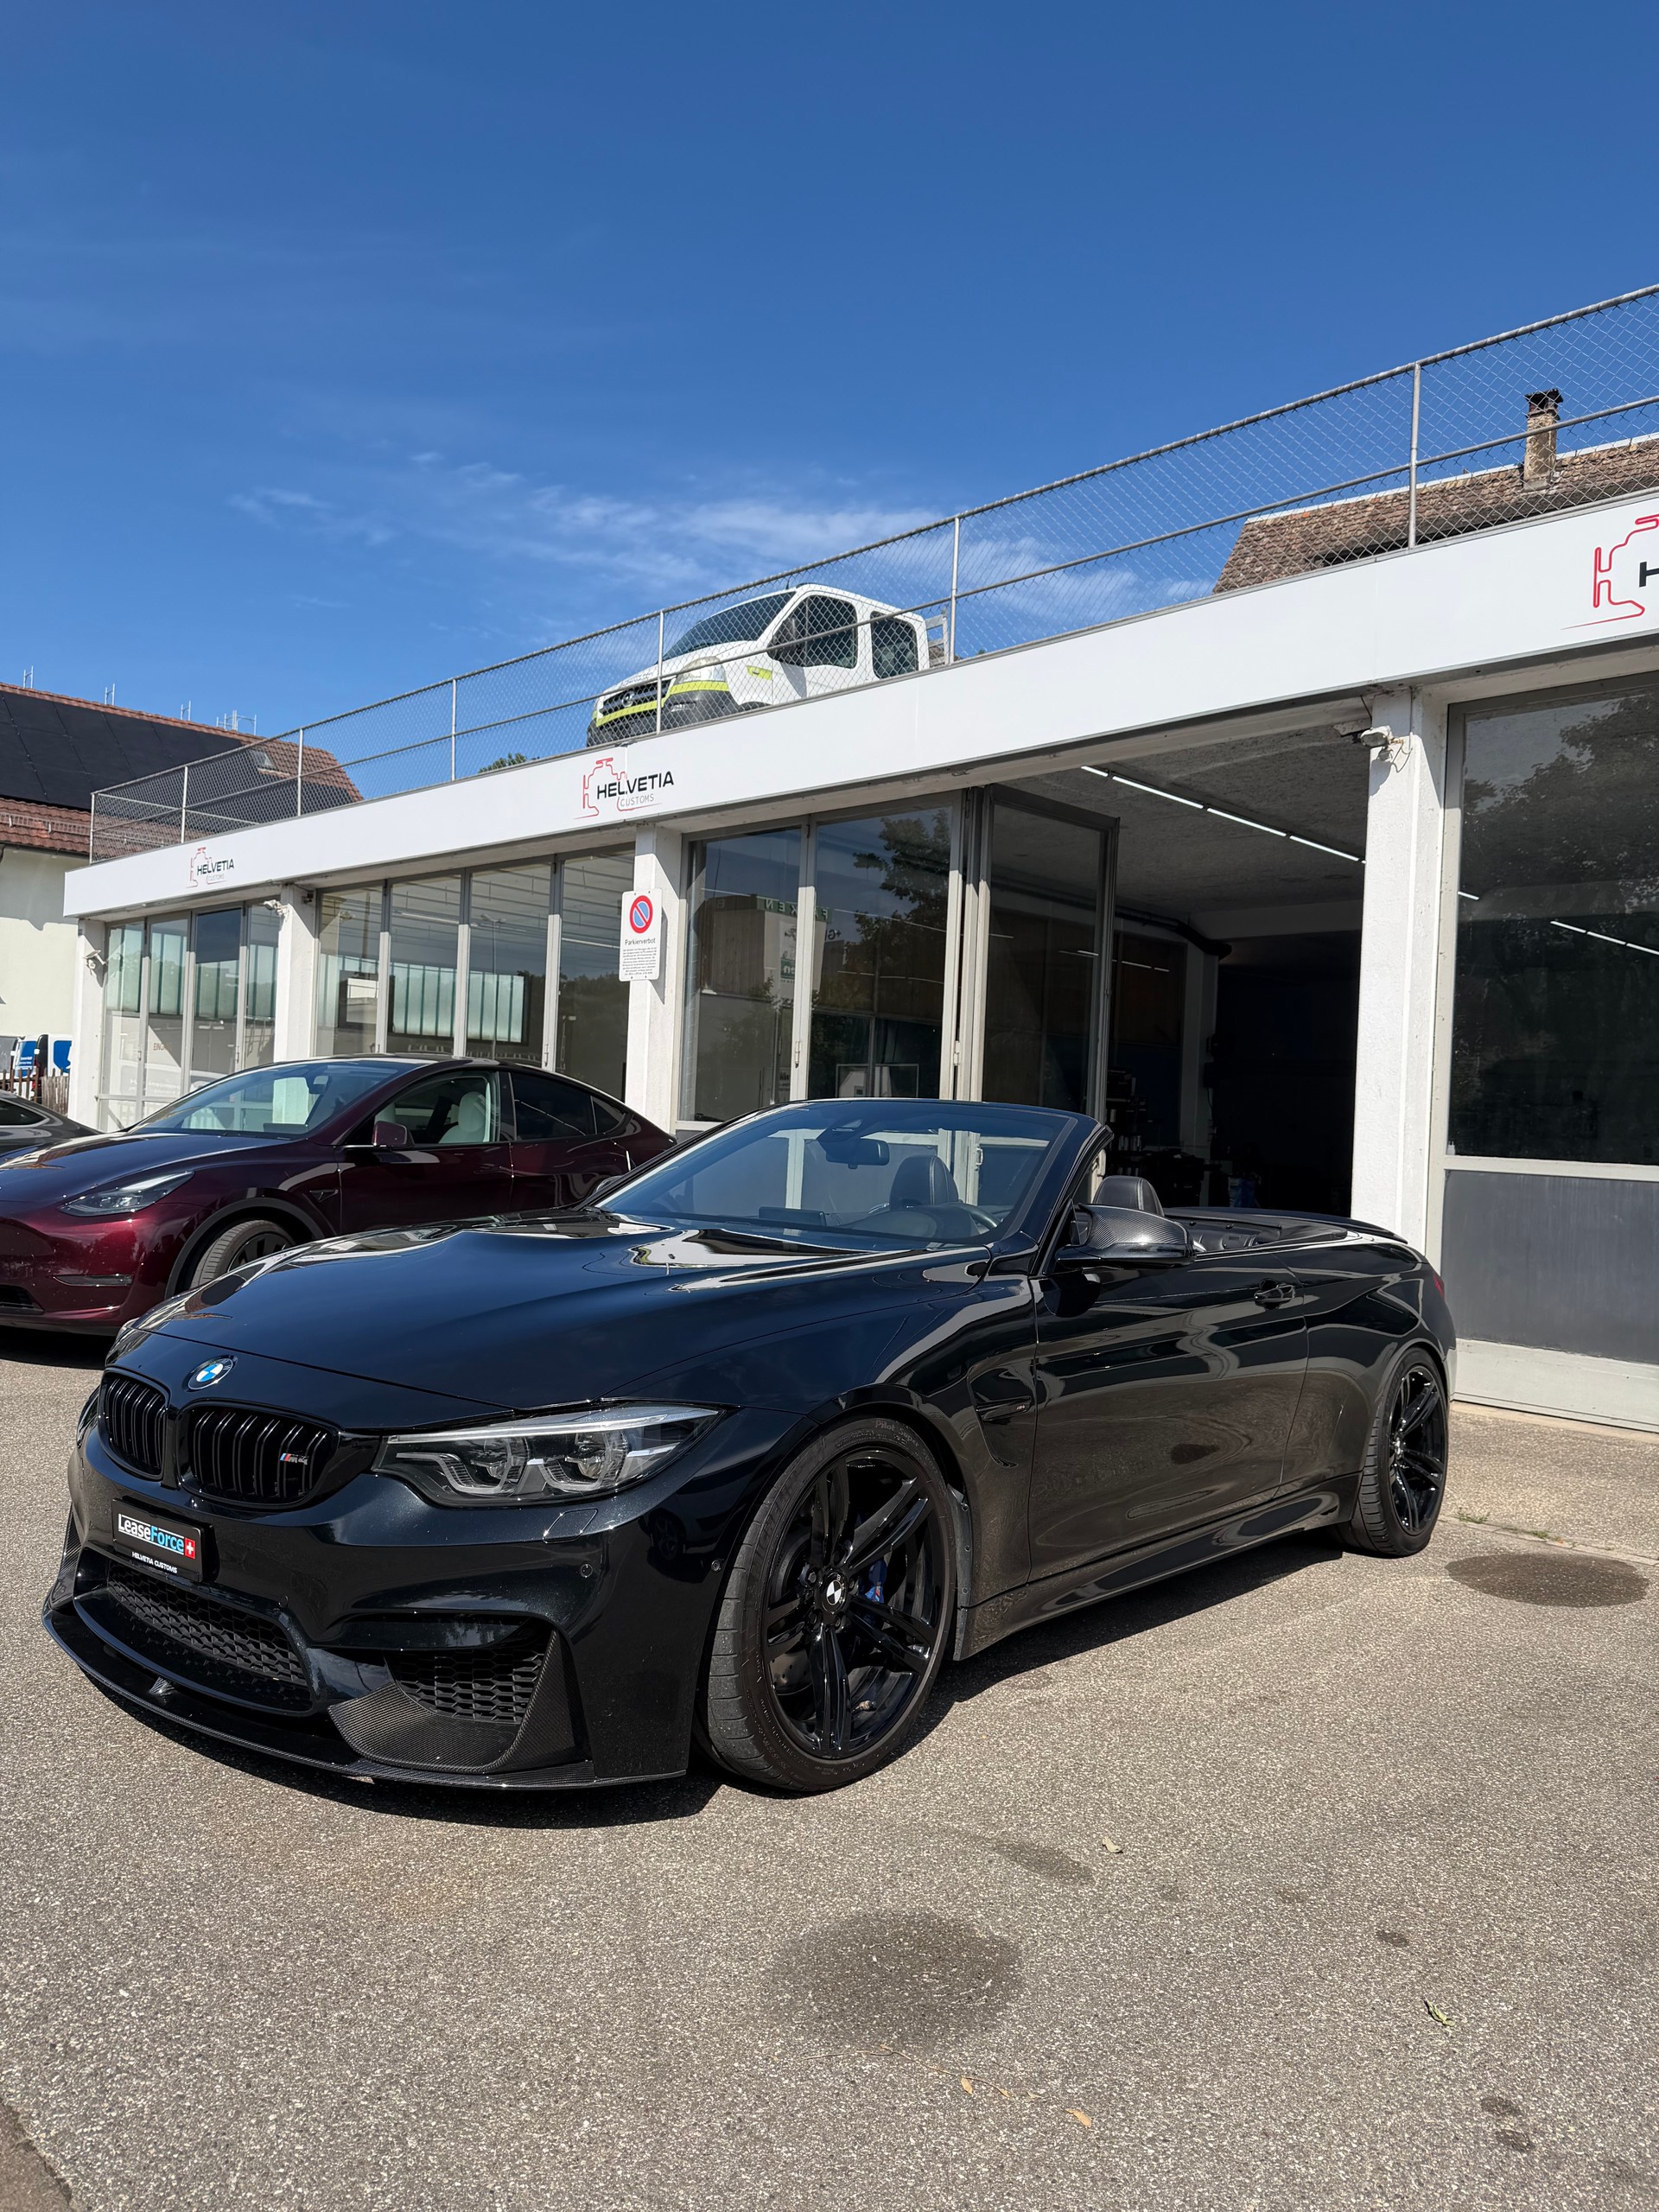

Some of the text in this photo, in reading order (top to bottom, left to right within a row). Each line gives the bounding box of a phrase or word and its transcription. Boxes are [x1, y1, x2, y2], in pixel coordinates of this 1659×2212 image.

[597, 771, 674, 799] HELVETIA
[620, 793, 655, 807] CUSTOMS
[196, 858, 234, 876] HELVETIA
[118, 1513, 184, 1553] LeaseForce
[131, 1551, 178, 1573] HELVETIA CUSTOMS
